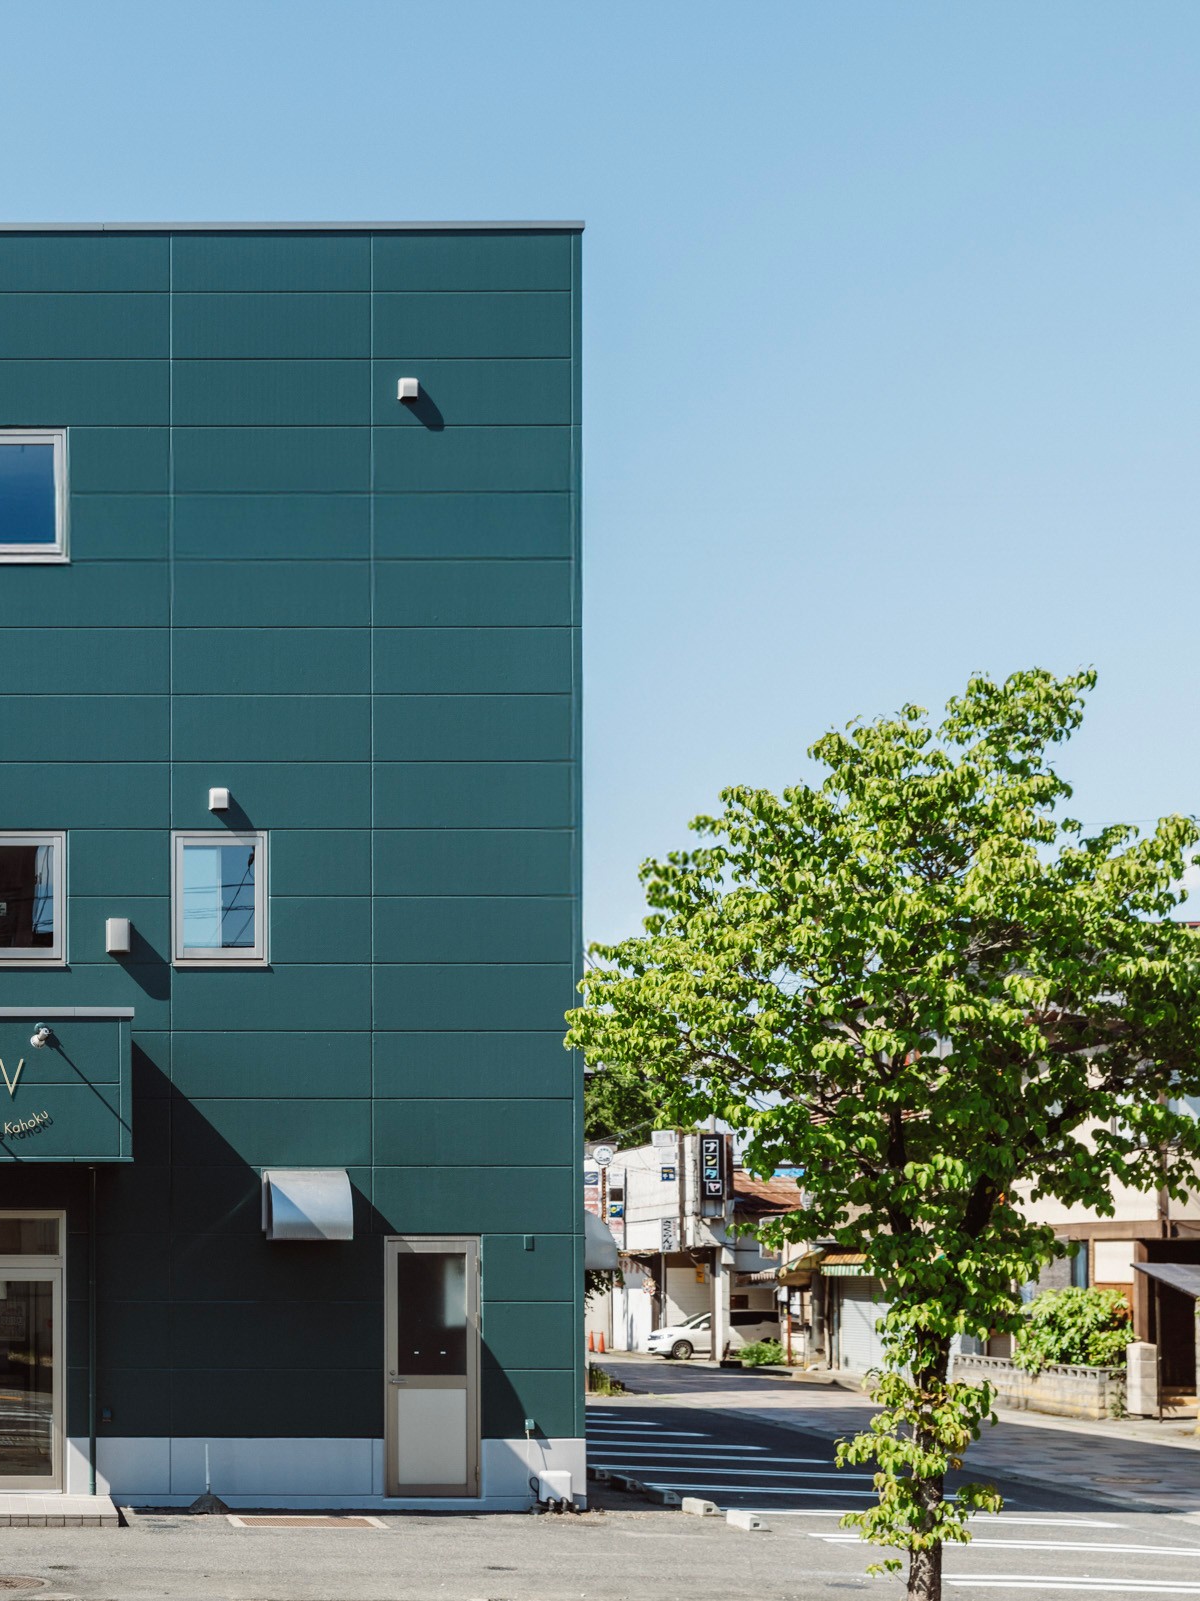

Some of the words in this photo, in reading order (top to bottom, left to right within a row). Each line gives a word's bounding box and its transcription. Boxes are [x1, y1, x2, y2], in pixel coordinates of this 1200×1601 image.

[4, 1110, 49, 1134] Kahoku
[705, 1142, 720, 1192] ナンタヤ
